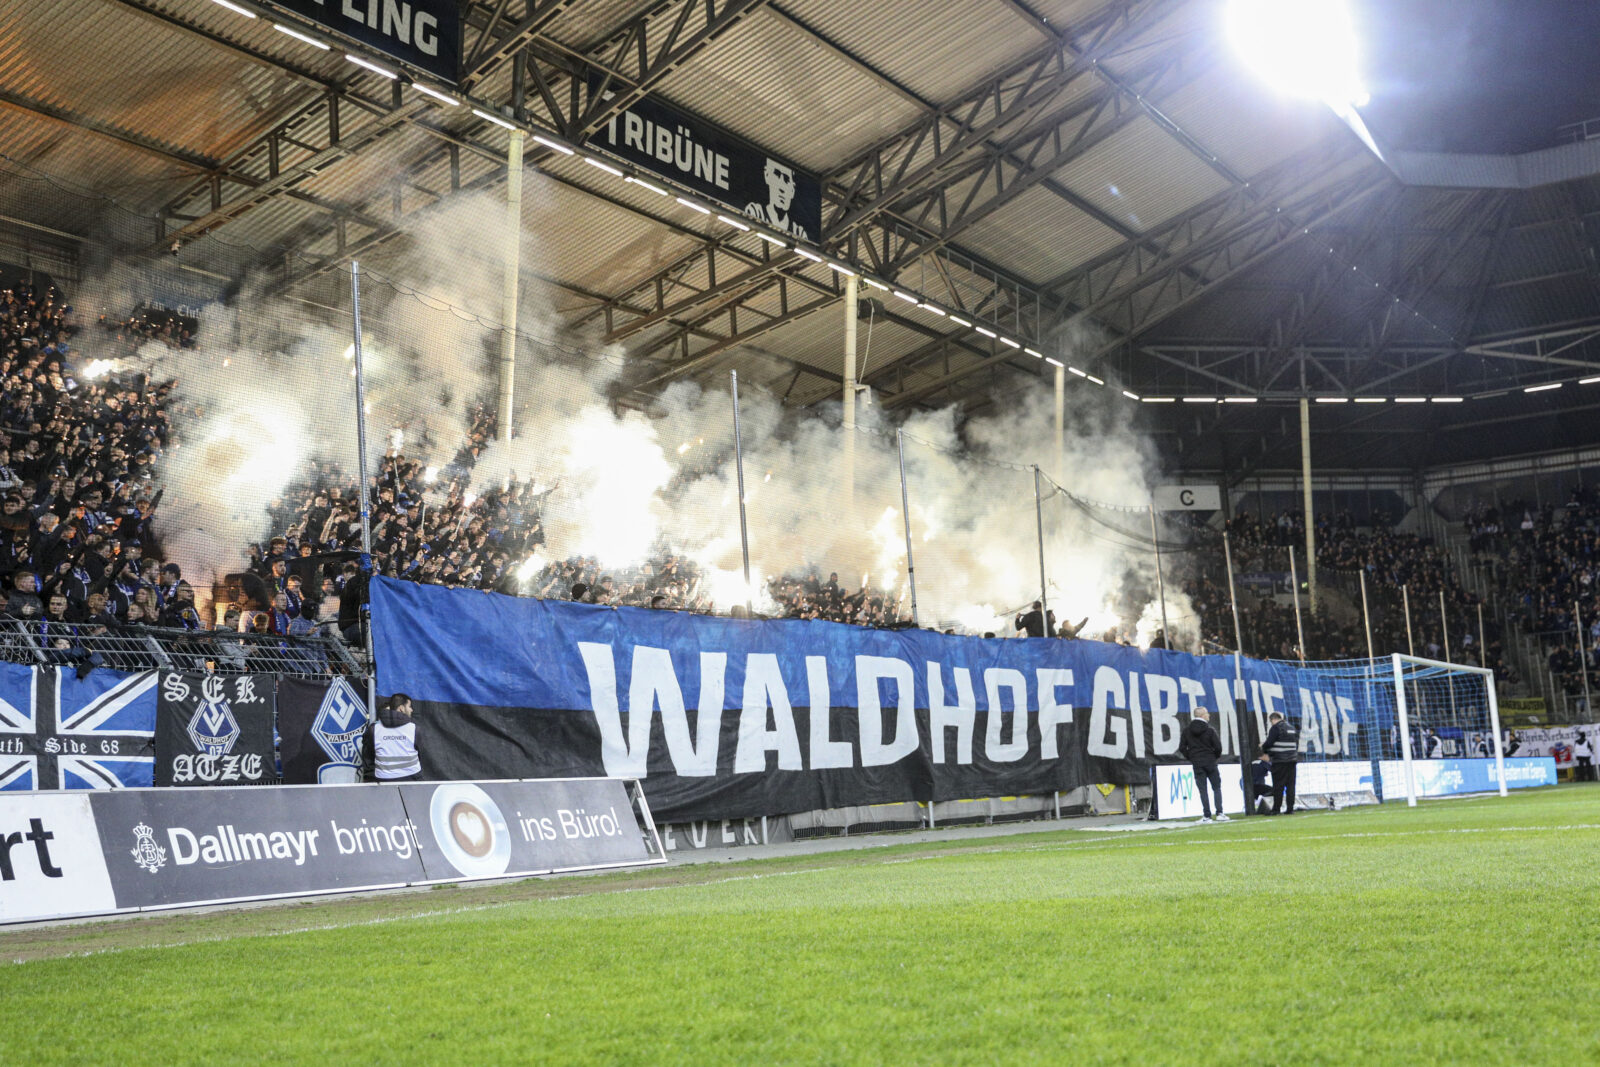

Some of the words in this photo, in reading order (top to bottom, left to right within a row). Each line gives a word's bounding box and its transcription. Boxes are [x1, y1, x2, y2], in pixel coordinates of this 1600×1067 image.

[314, 0, 438, 57] LING
[1180, 489, 1195, 507] C
[578, 641, 1075, 778] WALDHOF
[1087, 665, 1206, 759] GIBT
[1297, 687, 1359, 756] AUF
[44, 737, 88, 754] Side
[100, 739, 120, 754] 68
[0, 817, 63, 881] rt
[166, 824, 319, 866] Dallmayr
[331, 819, 423, 859] bringt
[516, 811, 557, 842] ins
[557, 806, 622, 840] Büro!
